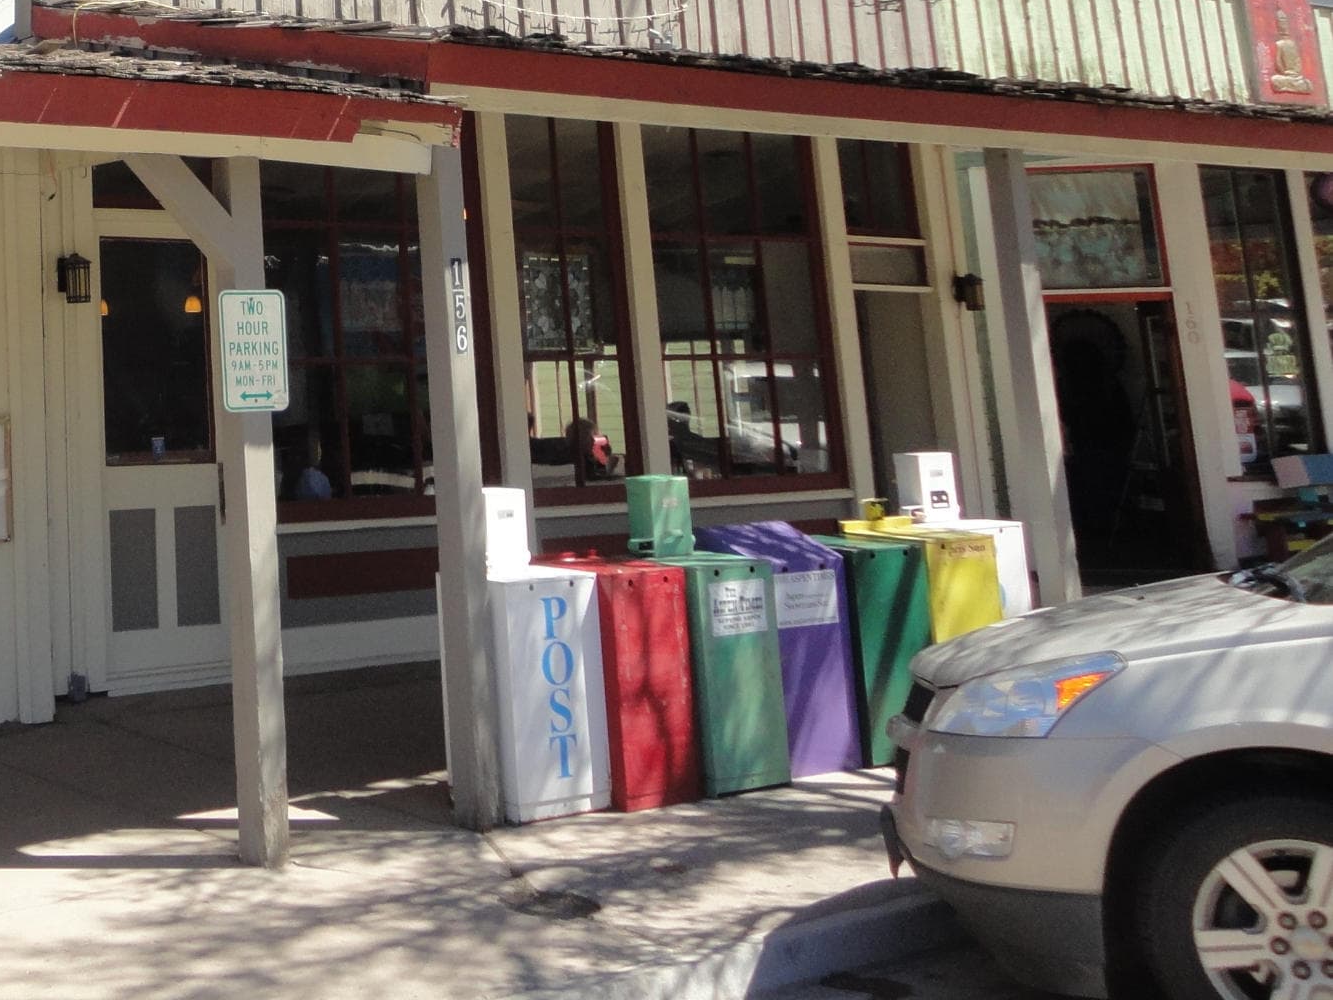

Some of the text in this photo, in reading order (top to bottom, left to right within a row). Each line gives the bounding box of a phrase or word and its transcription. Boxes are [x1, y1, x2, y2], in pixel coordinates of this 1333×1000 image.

[240, 300, 263, 316] TWO
[451, 257, 468, 355] 156
[236, 321, 269, 336] HOUR
[229, 340, 279, 357] PARKING
[235, 374, 277, 387] MON-FRI
[539, 595, 578, 779] POST
